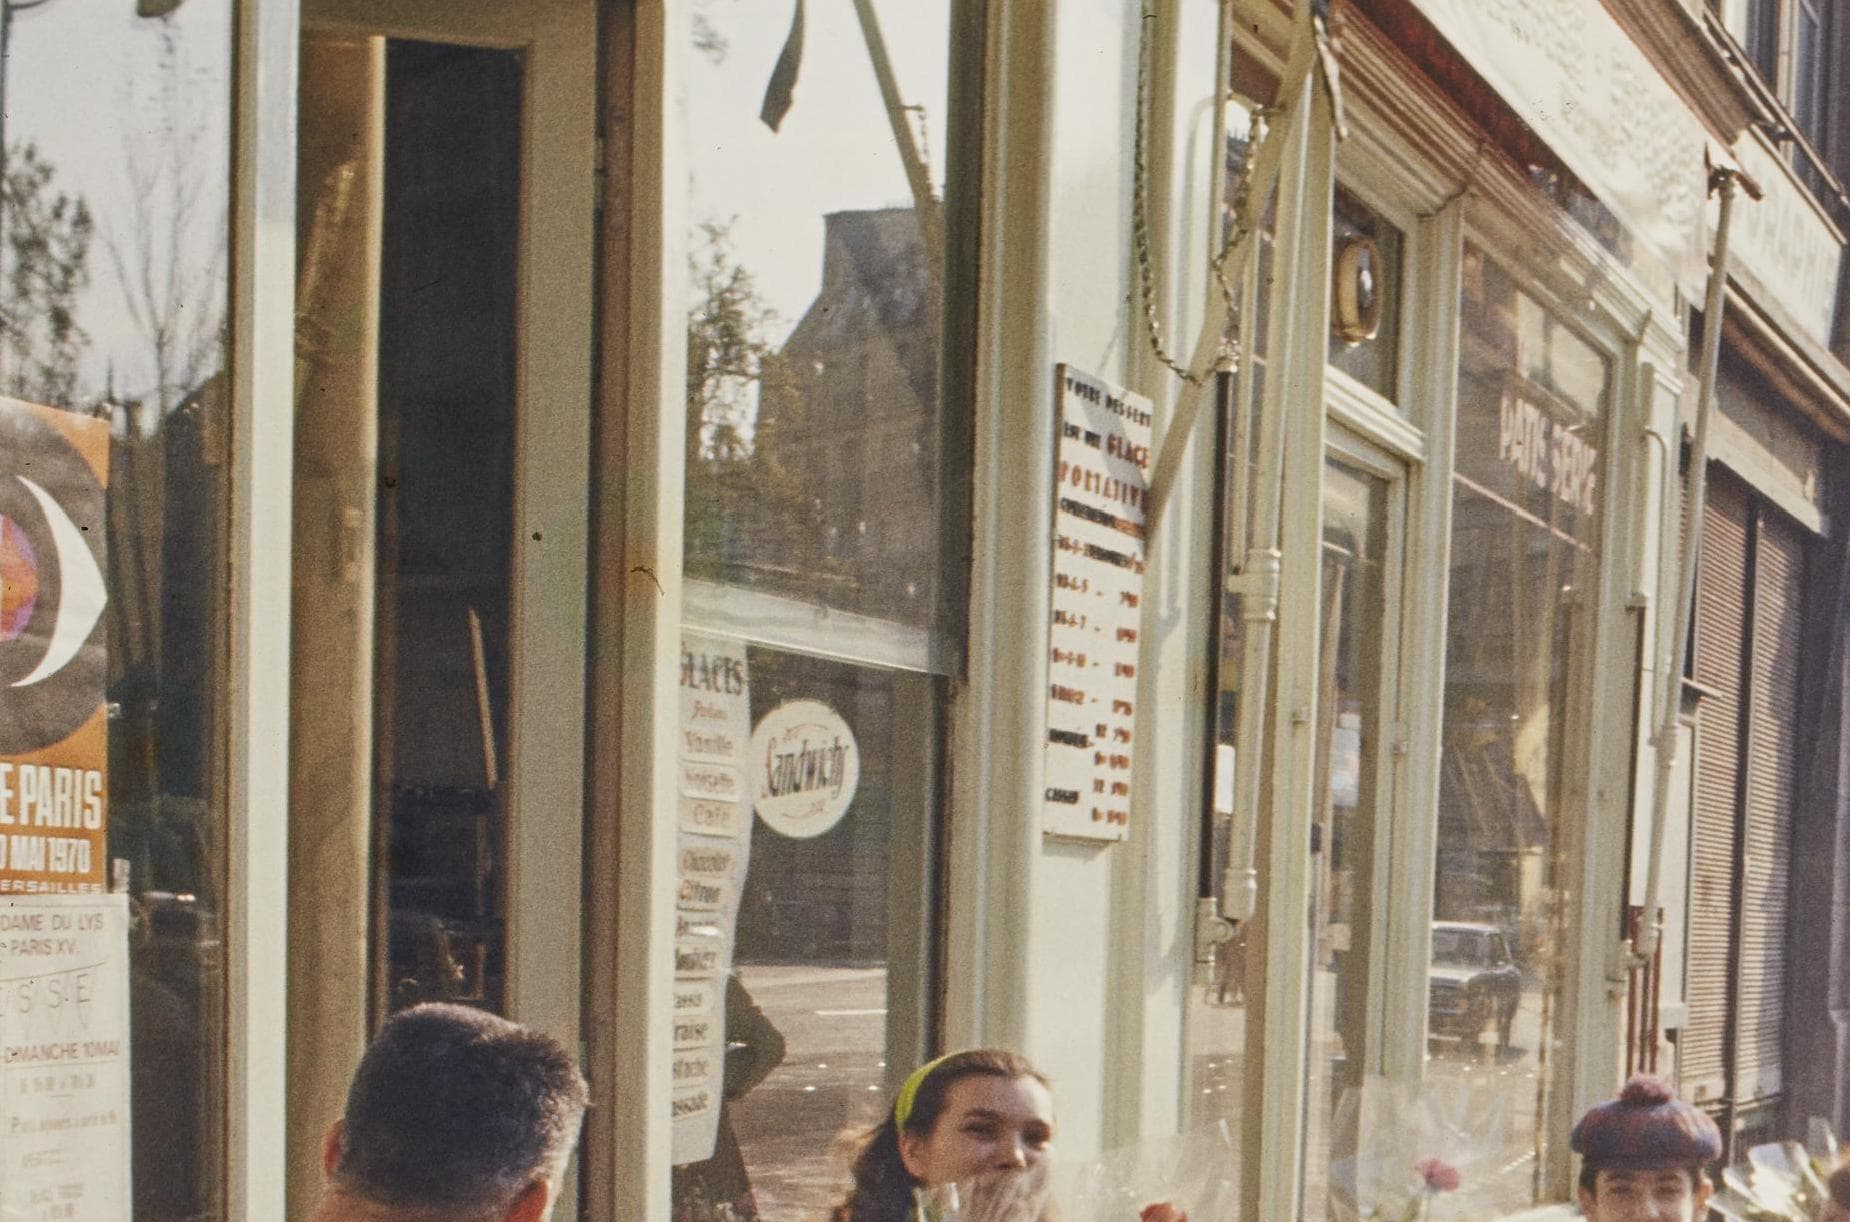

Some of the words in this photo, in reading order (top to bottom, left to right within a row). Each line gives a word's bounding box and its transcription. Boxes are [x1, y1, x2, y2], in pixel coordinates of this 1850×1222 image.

[1105, 393, 1150, 427] DESSERT
[1107, 432, 1148, 469] GLACE
[20, 764, 101, 830] PARIS
[10, 835, 45, 871] MAI
[47, 837, 91, 874] 1970
[0, 879, 101, 894] ERSAILLES
[0, 914, 44, 931] DAME
[52, 914, 71, 931] DU
[78, 913, 104, 931] LYS
[11, 938, 52, 956] PARIS
[674, 1022, 709, 1042] raise
[4, 1043, 79, 1063] DIMANCHE
